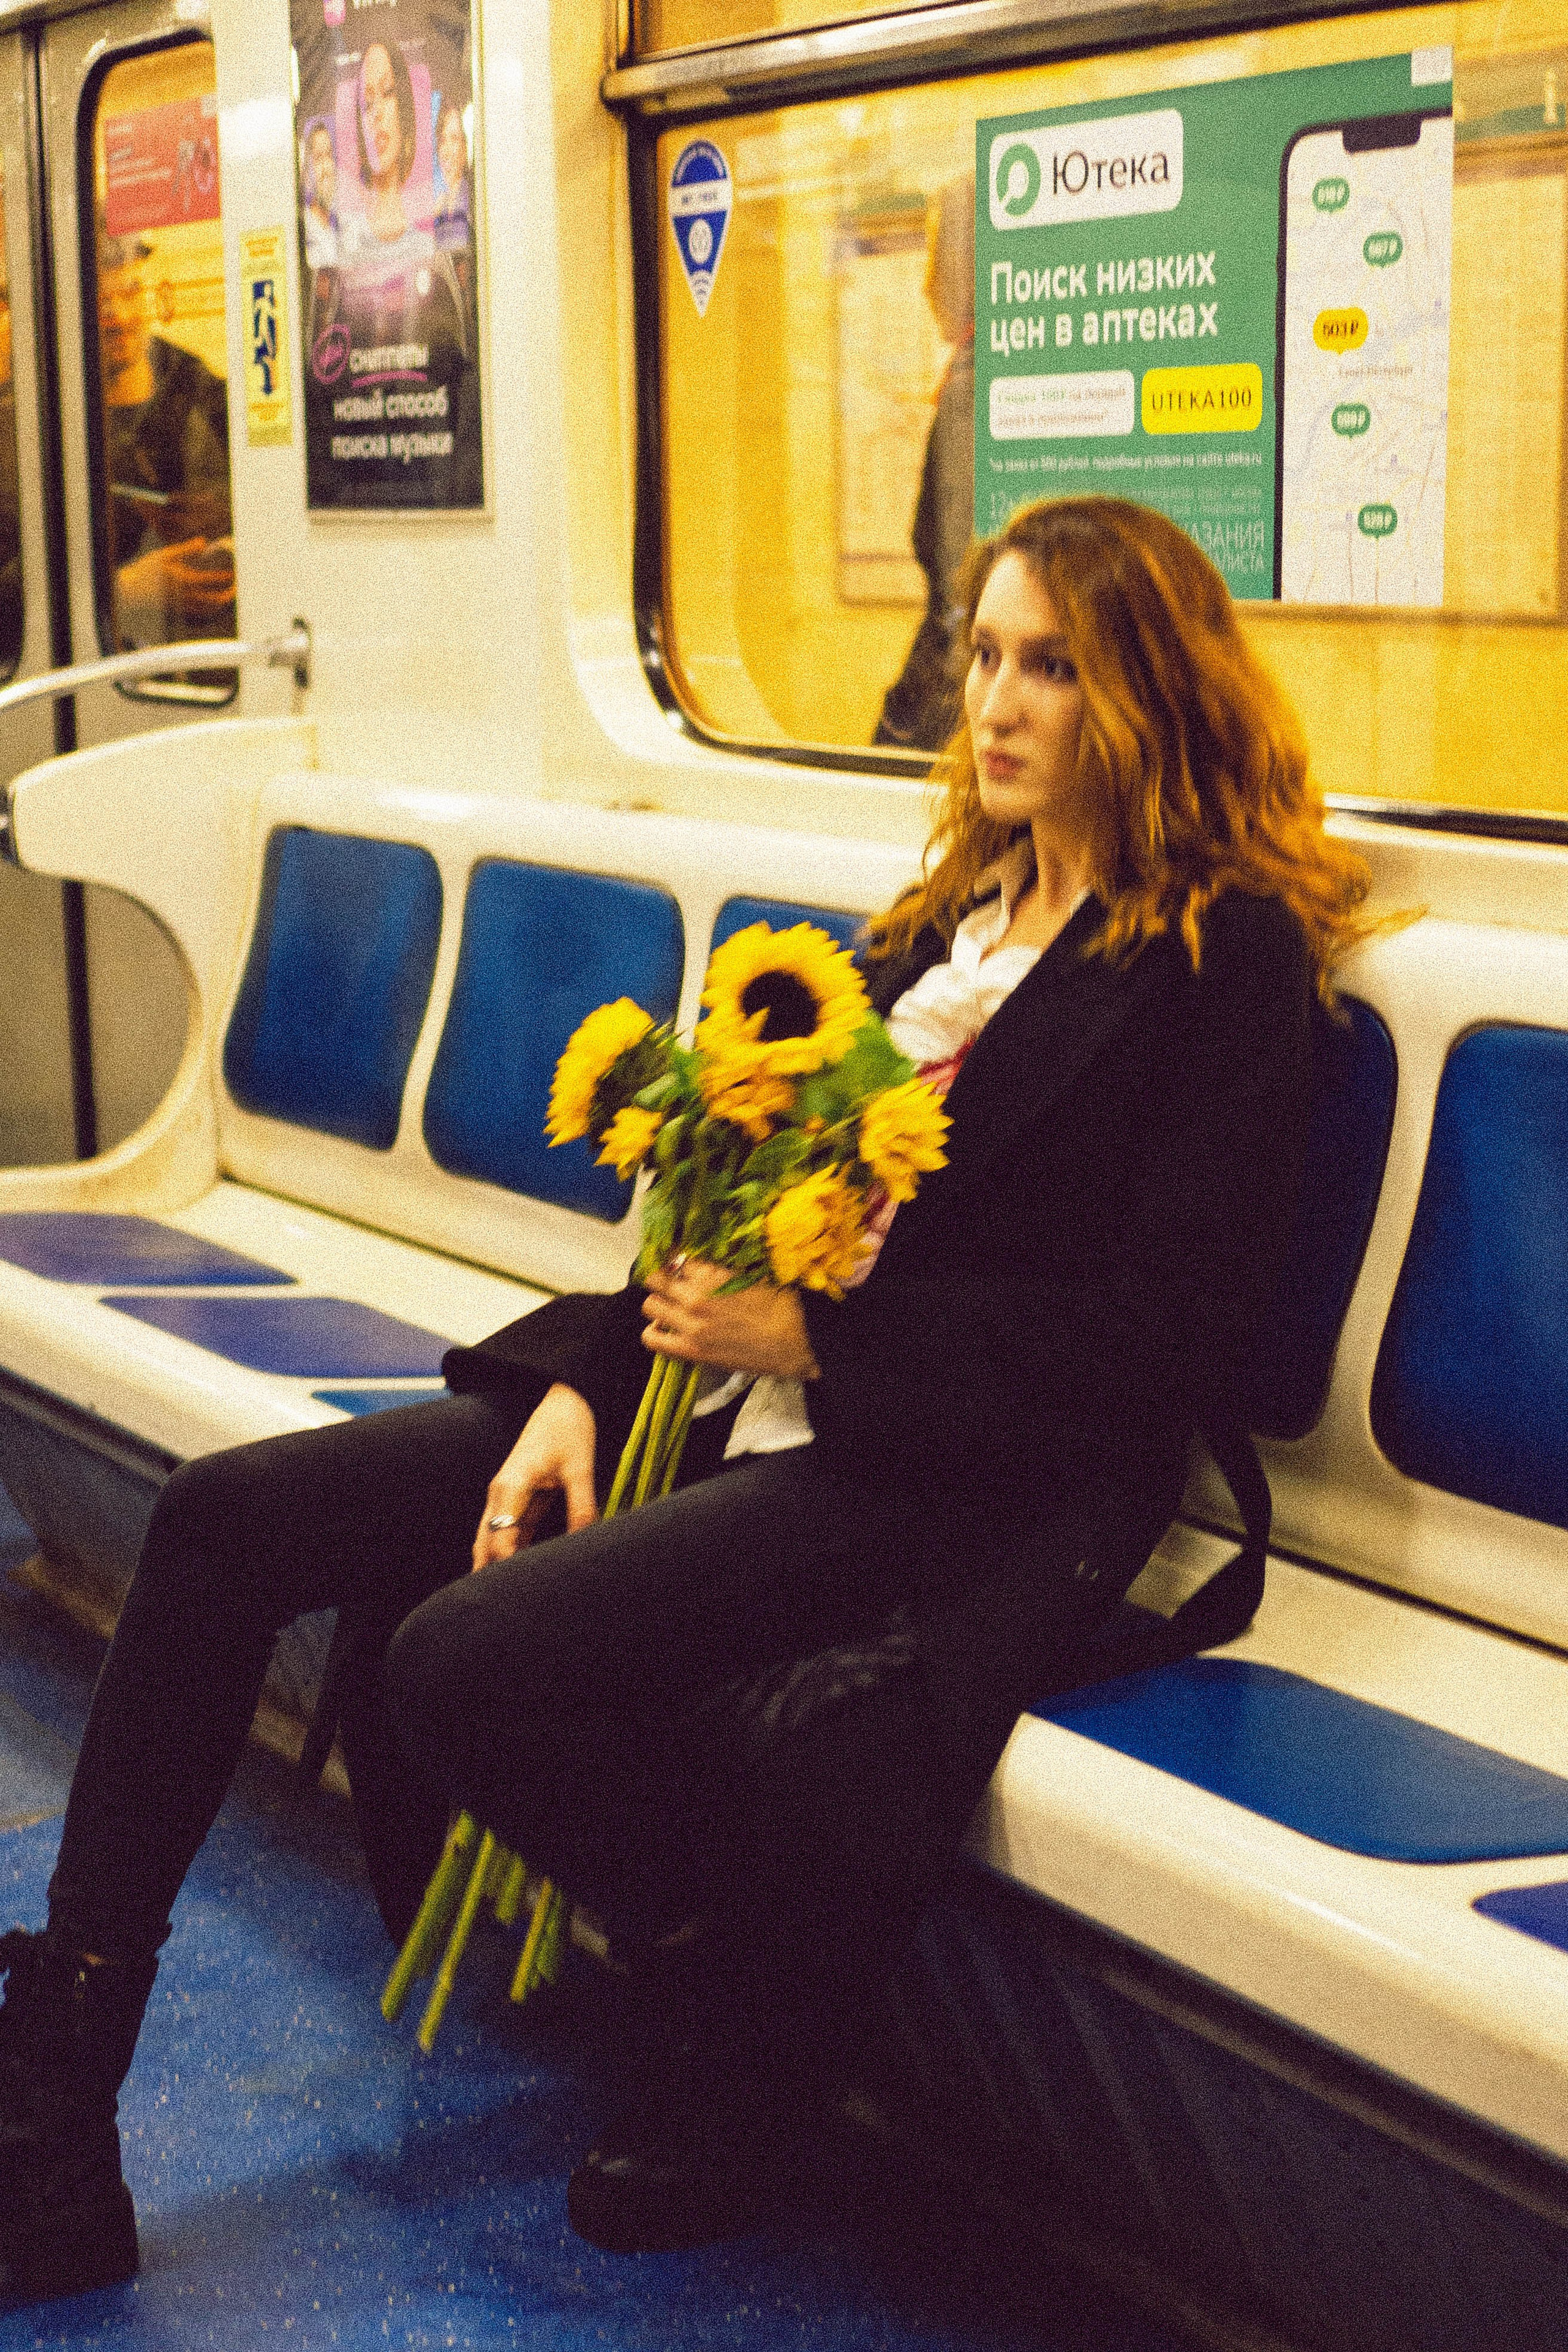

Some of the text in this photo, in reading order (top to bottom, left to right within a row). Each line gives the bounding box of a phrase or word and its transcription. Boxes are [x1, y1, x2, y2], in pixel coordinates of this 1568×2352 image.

[1052, 149, 1170, 195] Ютека
[990, 252, 1217, 305] Поиск низких
[990, 302, 1219, 356] цен в аптеках
[386, 385, 449, 418] способ
[1151, 386, 1253, 413] UTEKA100
[1185, 519, 1265, 551] АЗАНИЯ
